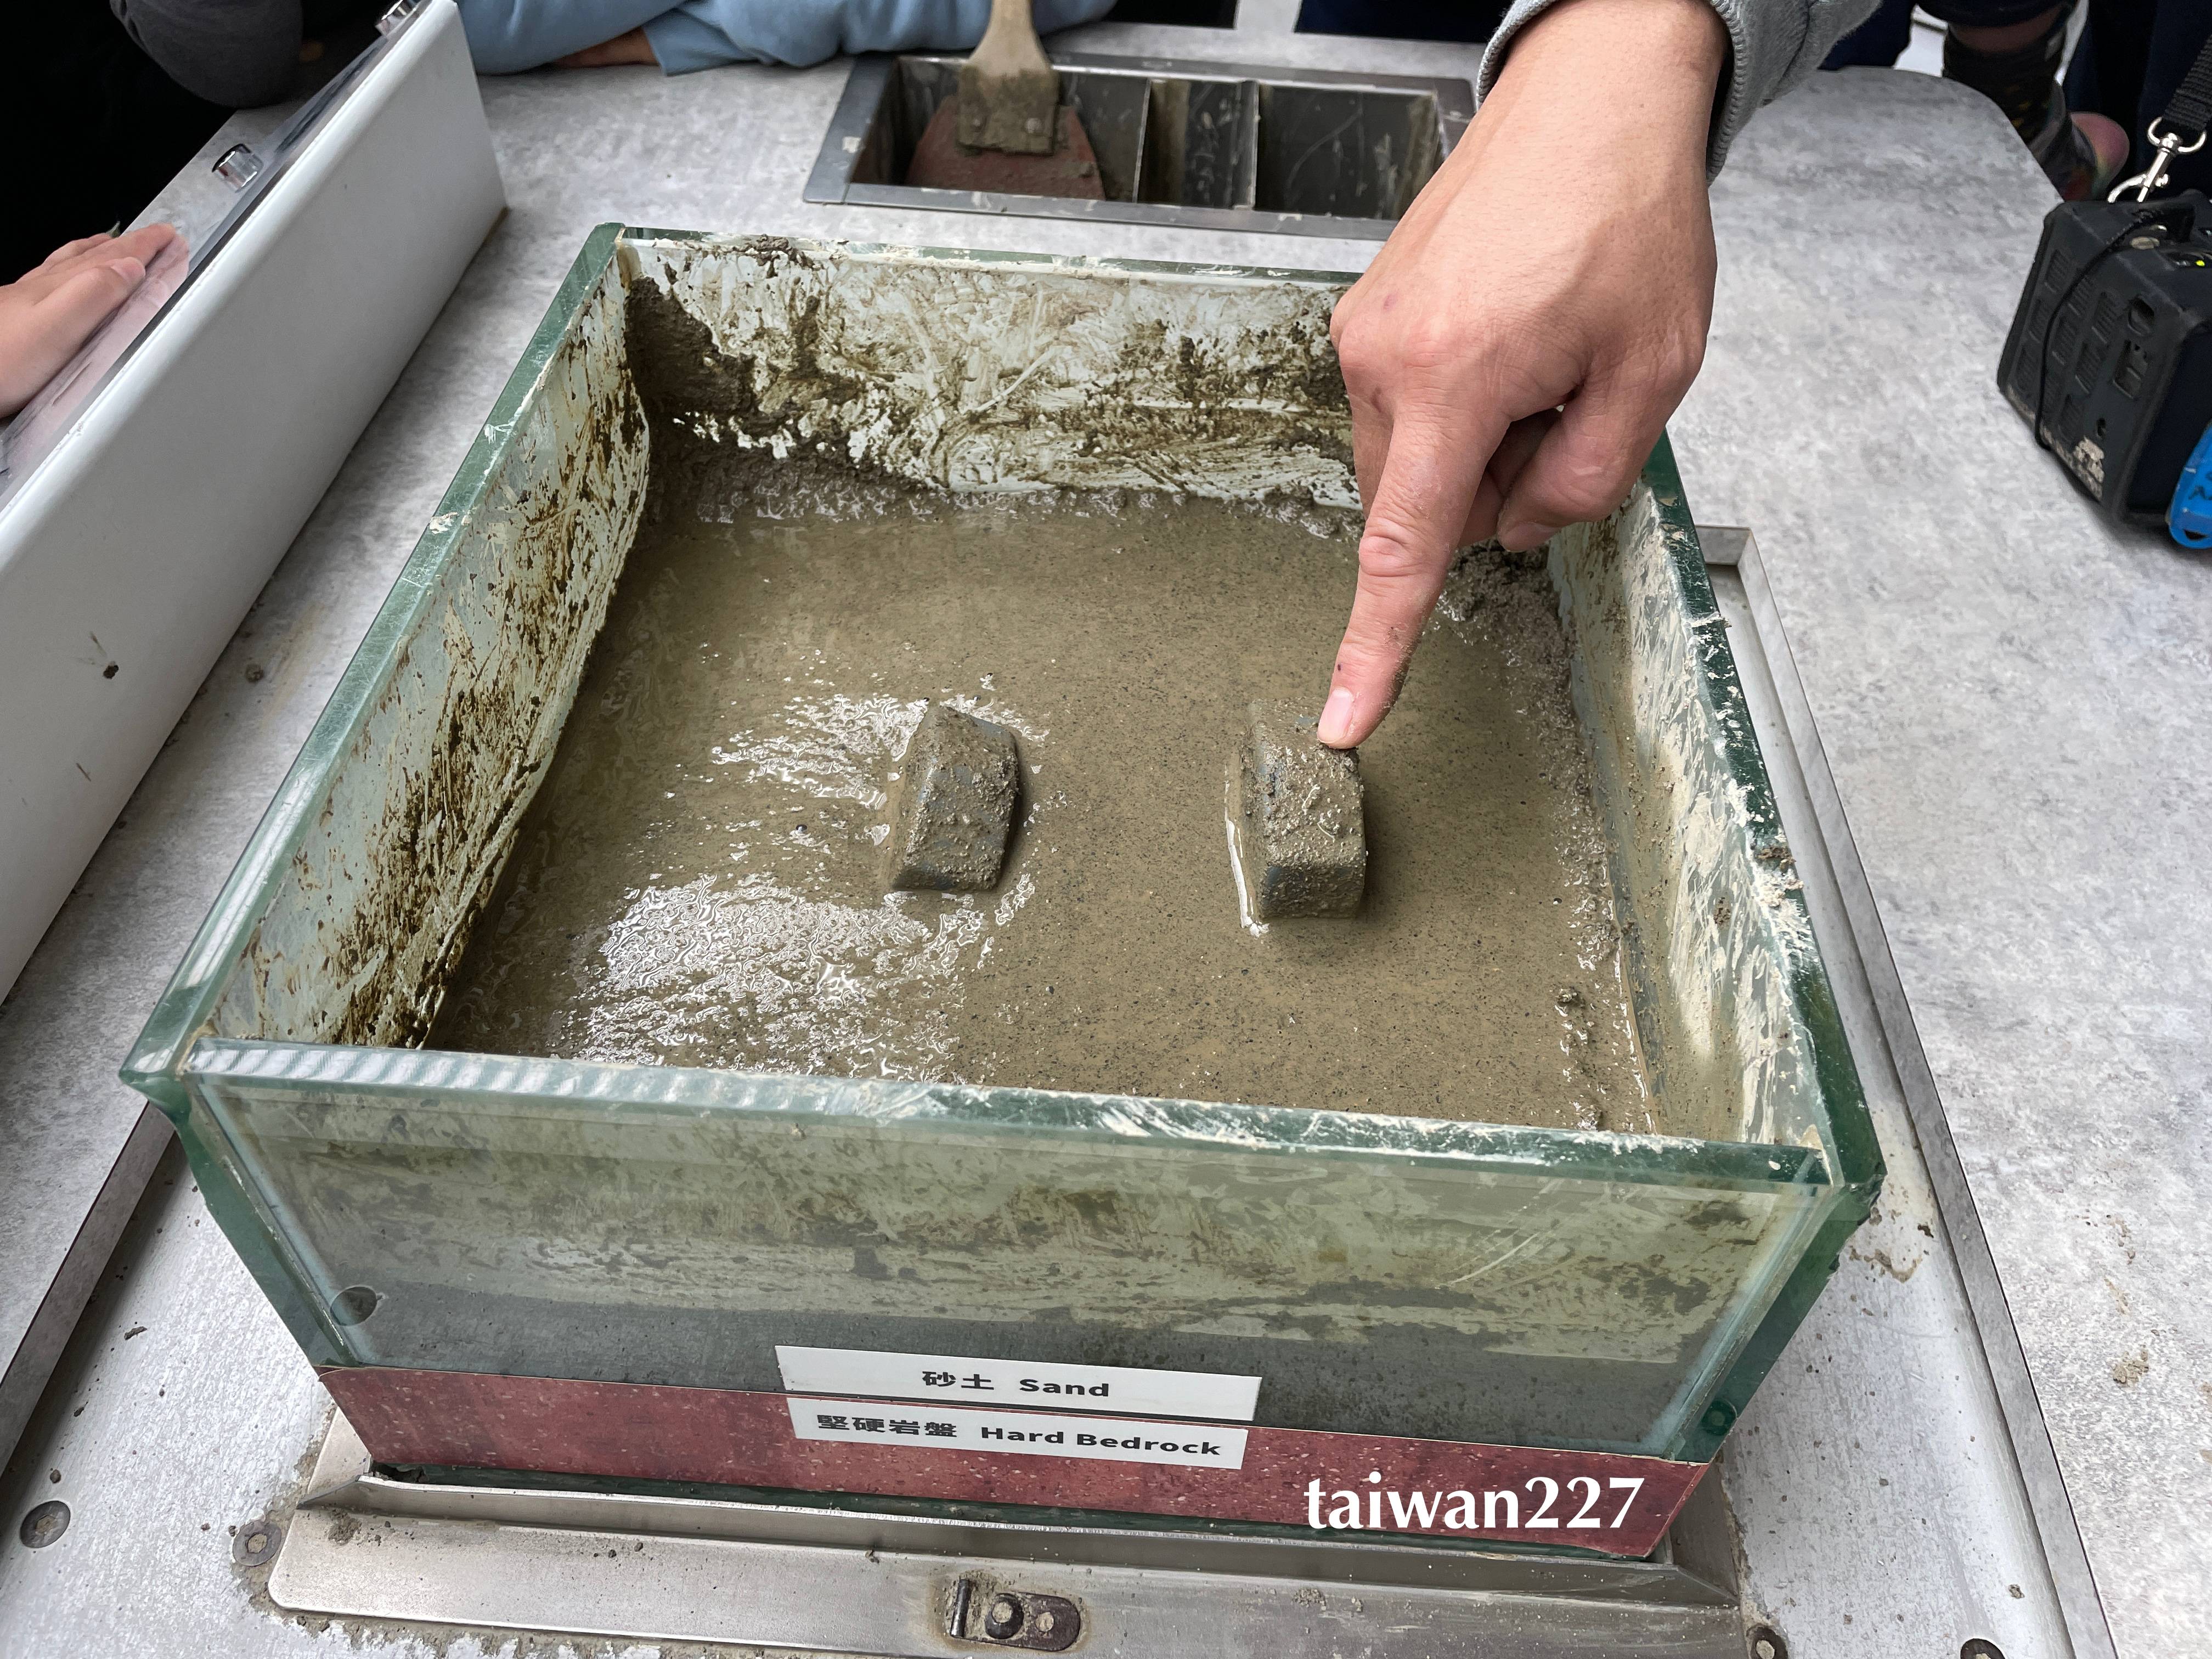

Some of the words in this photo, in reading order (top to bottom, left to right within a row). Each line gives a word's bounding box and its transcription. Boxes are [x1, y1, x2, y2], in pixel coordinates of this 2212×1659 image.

[922, 1371, 995, 1390] 砂土
[1019, 1379, 1109, 1397] Sand
[817, 1414, 957, 1437] 堅硬岩盤
[981, 1427, 1064, 1444] Hard
[1076, 1434, 1221, 1455] Bedrock
